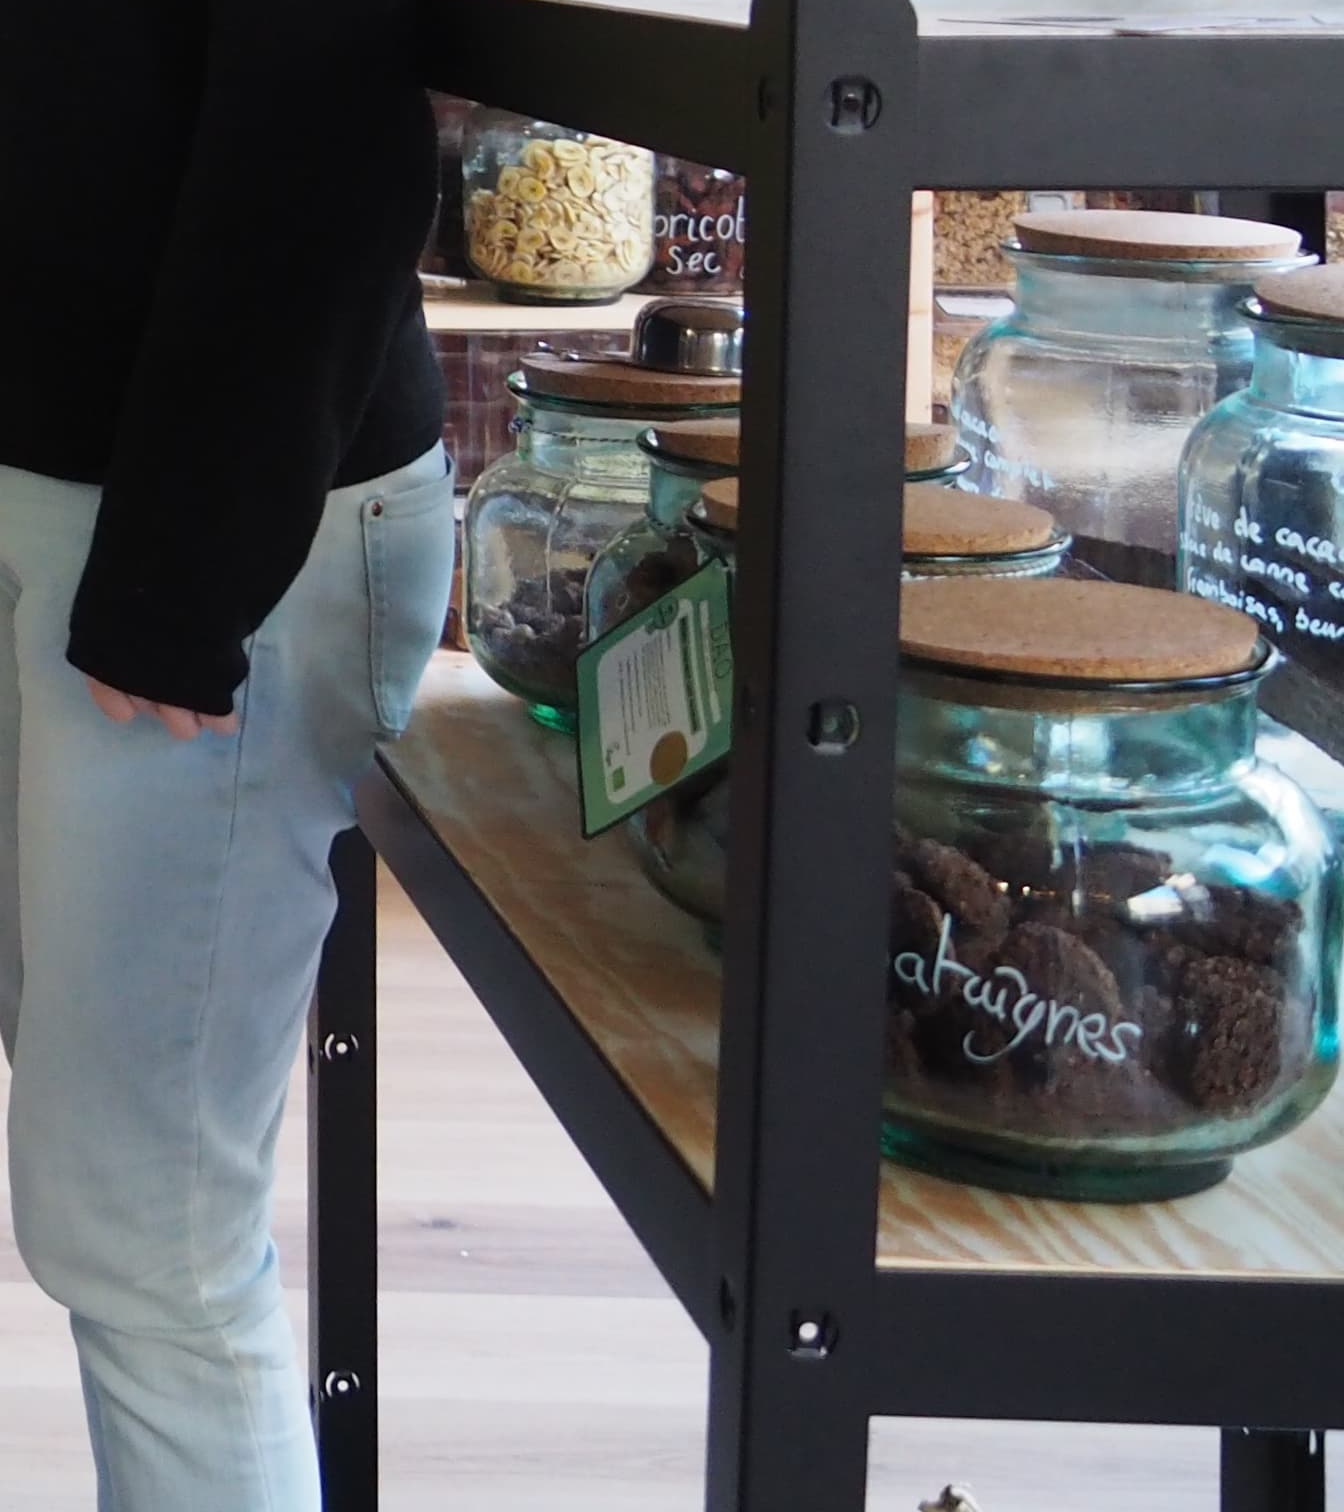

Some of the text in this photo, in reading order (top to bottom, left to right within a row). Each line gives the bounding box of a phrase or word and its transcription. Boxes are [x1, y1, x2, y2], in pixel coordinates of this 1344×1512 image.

[665, 245, 721, 275] Sec
[1234, 505, 1263, 544] de
[1213, 540, 1233, 565] de
[1240, 554, 1311, 594] canne
